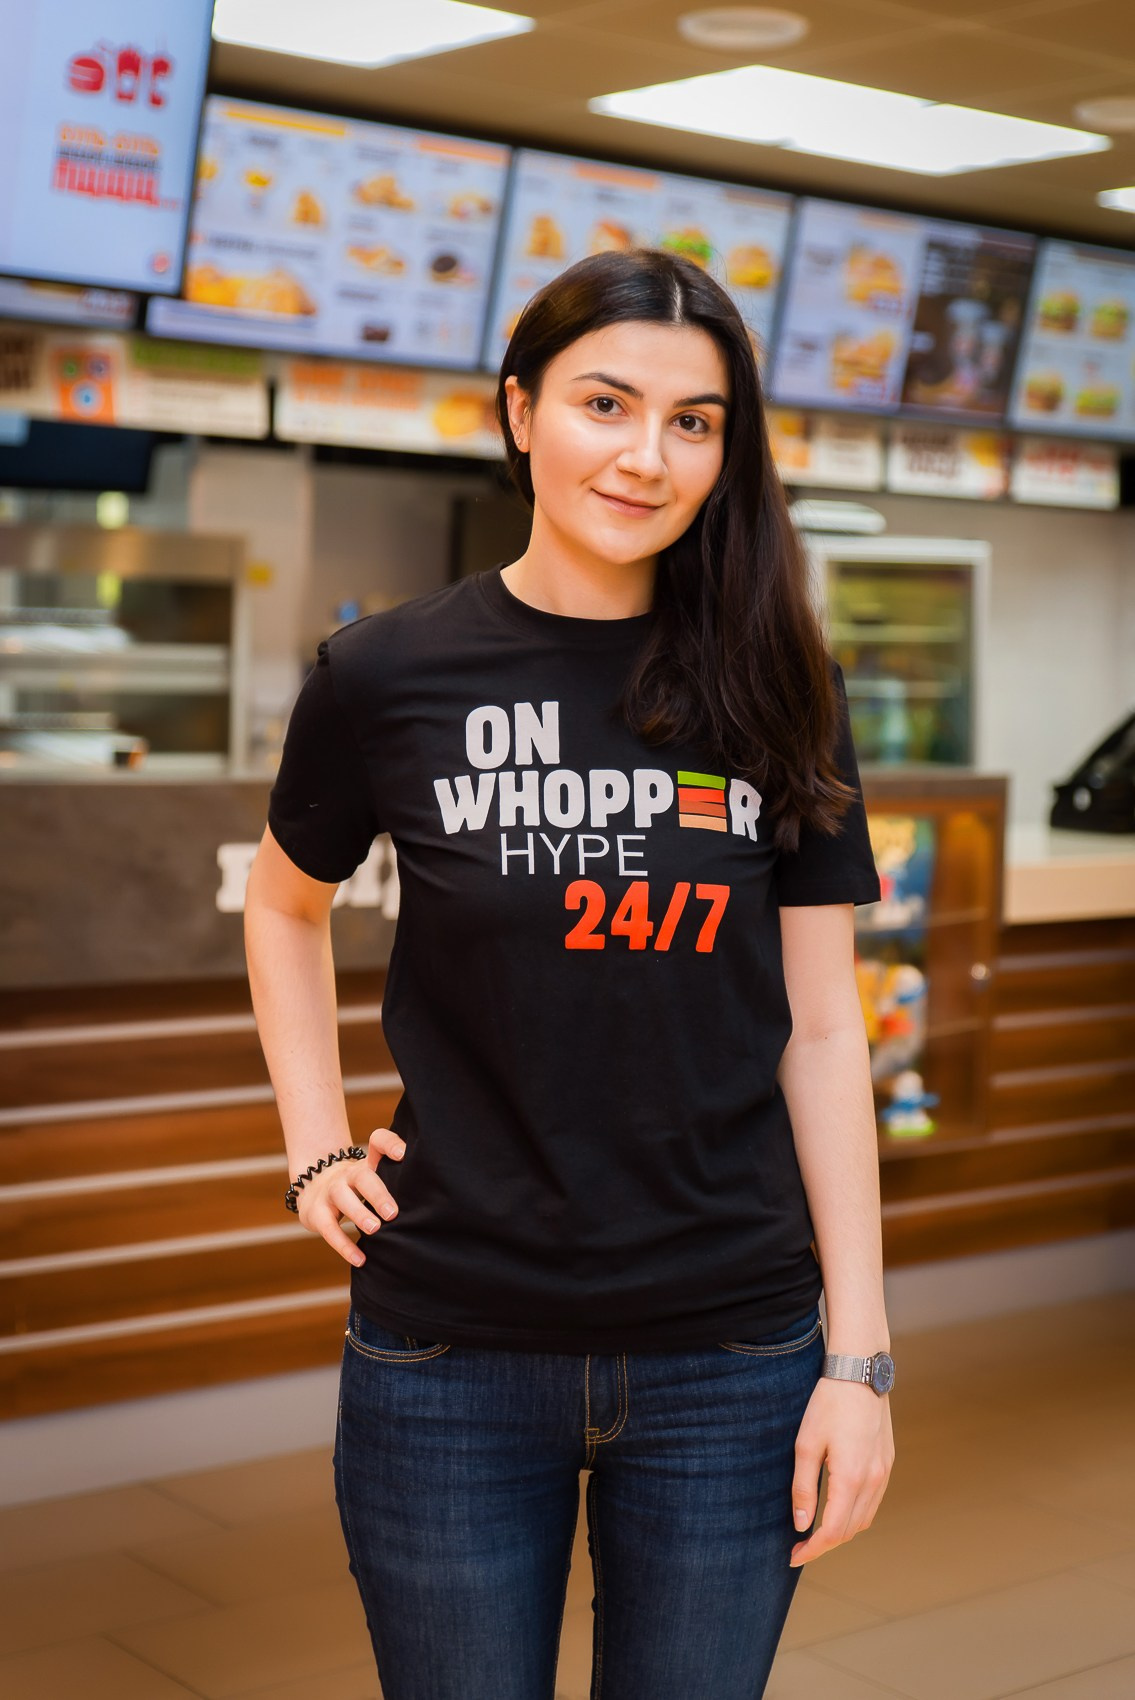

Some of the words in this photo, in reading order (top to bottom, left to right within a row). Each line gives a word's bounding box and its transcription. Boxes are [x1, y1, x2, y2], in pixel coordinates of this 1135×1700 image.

[465, 701, 560, 770] ON
[433, 769, 762, 842] WHOPPER
[501, 833, 649, 877] HYPE
[564, 880, 731, 953] 24/7
